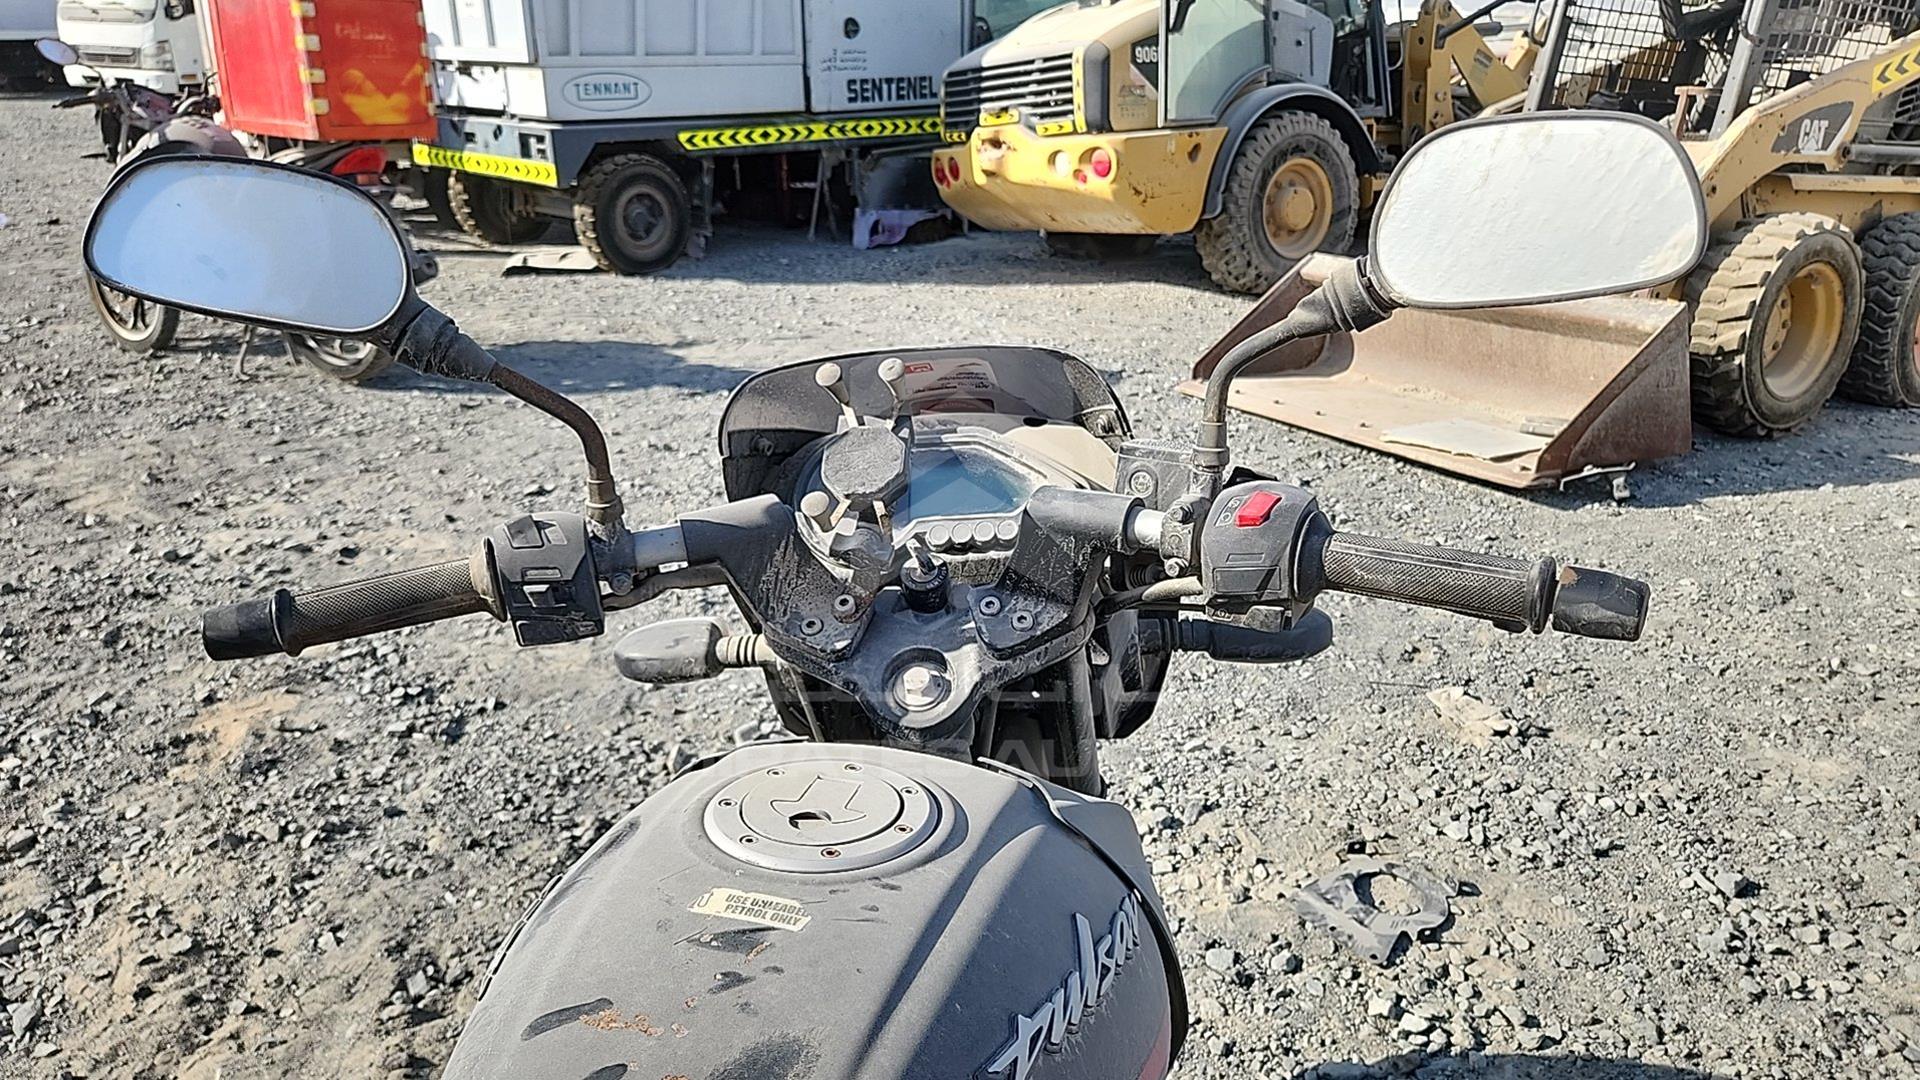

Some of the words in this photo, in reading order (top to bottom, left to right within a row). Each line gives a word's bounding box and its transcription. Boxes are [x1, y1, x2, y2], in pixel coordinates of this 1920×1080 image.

[573, 82, 640, 102] TENNANT
[846, 75, 938, 104] SENTENEL
[1798, 118, 1829, 151] CAT
[725, 893, 751, 906] USE
[724, 903, 769, 920] PETROL
[770, 911, 802, 926] ONLY
